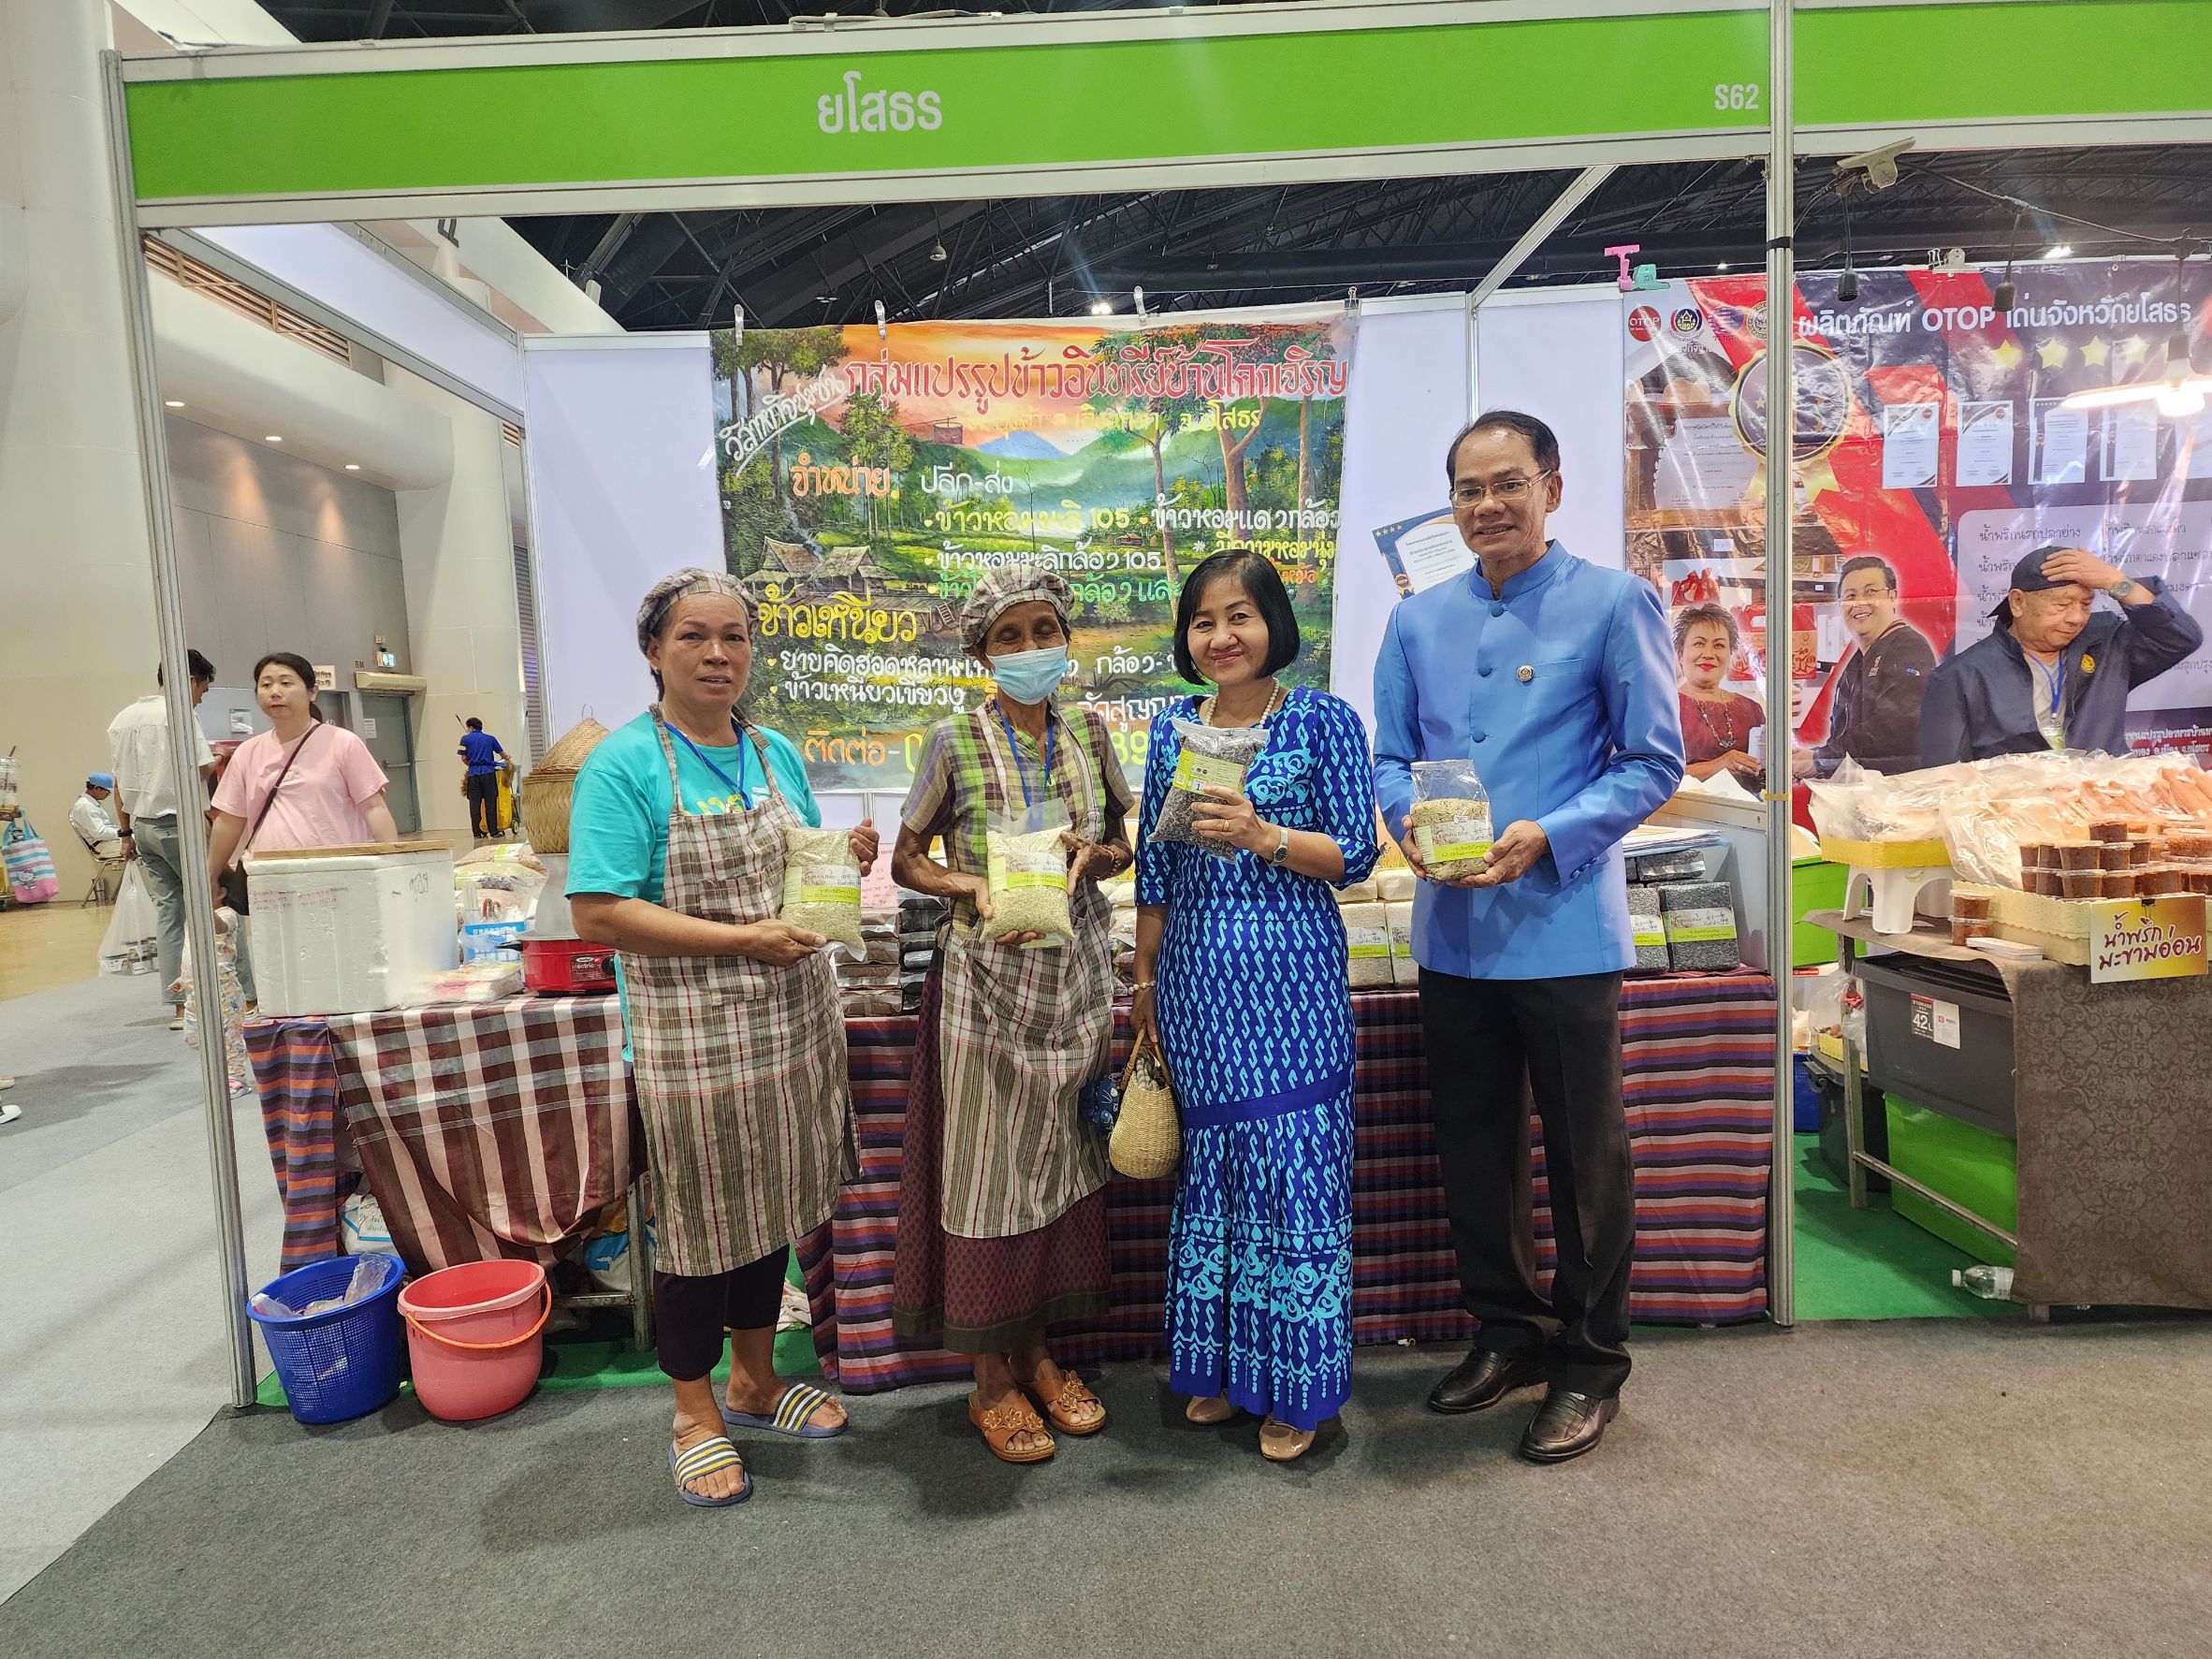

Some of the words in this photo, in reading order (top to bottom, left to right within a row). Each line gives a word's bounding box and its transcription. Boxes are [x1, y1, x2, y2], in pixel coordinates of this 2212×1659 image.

[817, 70, 943, 134] ยโสธร
[1714, 83, 1759, 110] S62
[1798, 300, 1914, 338] ผลิตภัณฑ์
[1922, 306, 1995, 333] OTOP
[790, 453, 890, 498] จำหน่าย
[921, 459, 1014, 496] ปลีก-ส่ง
[935, 499, 1083, 534] ข้าวหอมมะลิ
[1089, 507, 1130, 529] 105
[1125, 551, 1161, 570] 105
[758, 584, 918, 644] ข้าวเหนียว
[2099, 924, 2203, 971] มะขามอ่อน
[2103, 910, 2162, 949] น้ำพริก
